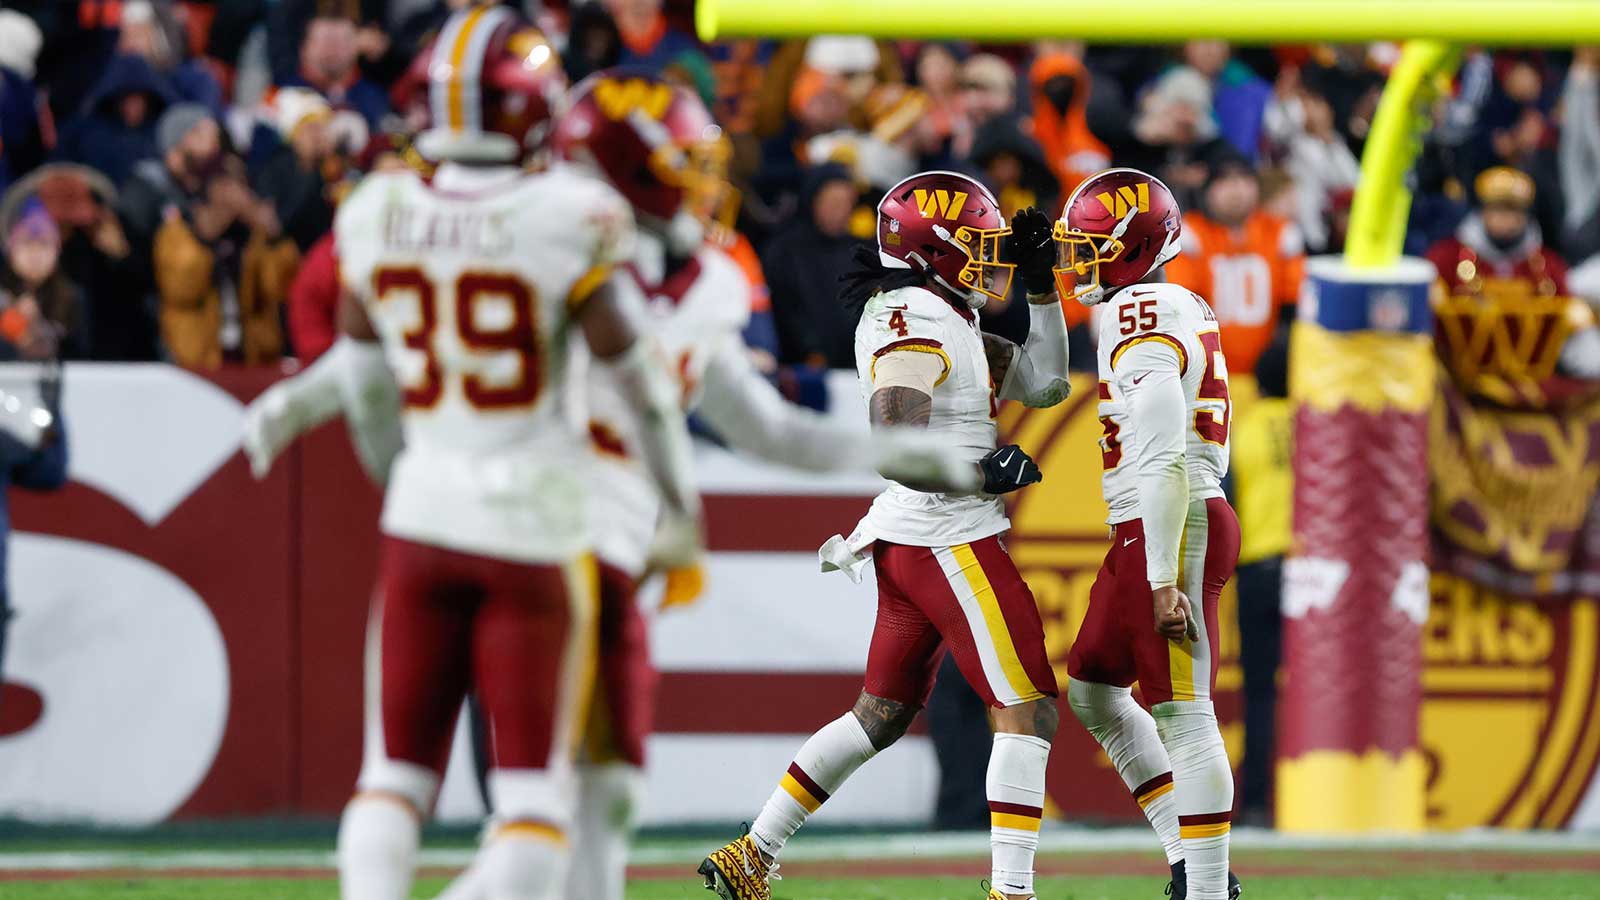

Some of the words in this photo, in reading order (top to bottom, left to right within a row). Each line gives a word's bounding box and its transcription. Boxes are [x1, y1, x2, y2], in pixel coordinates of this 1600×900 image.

[887, 309, 910, 338] 4
[1118, 300, 1158, 335] 55
[370, 264, 546, 413] 39
